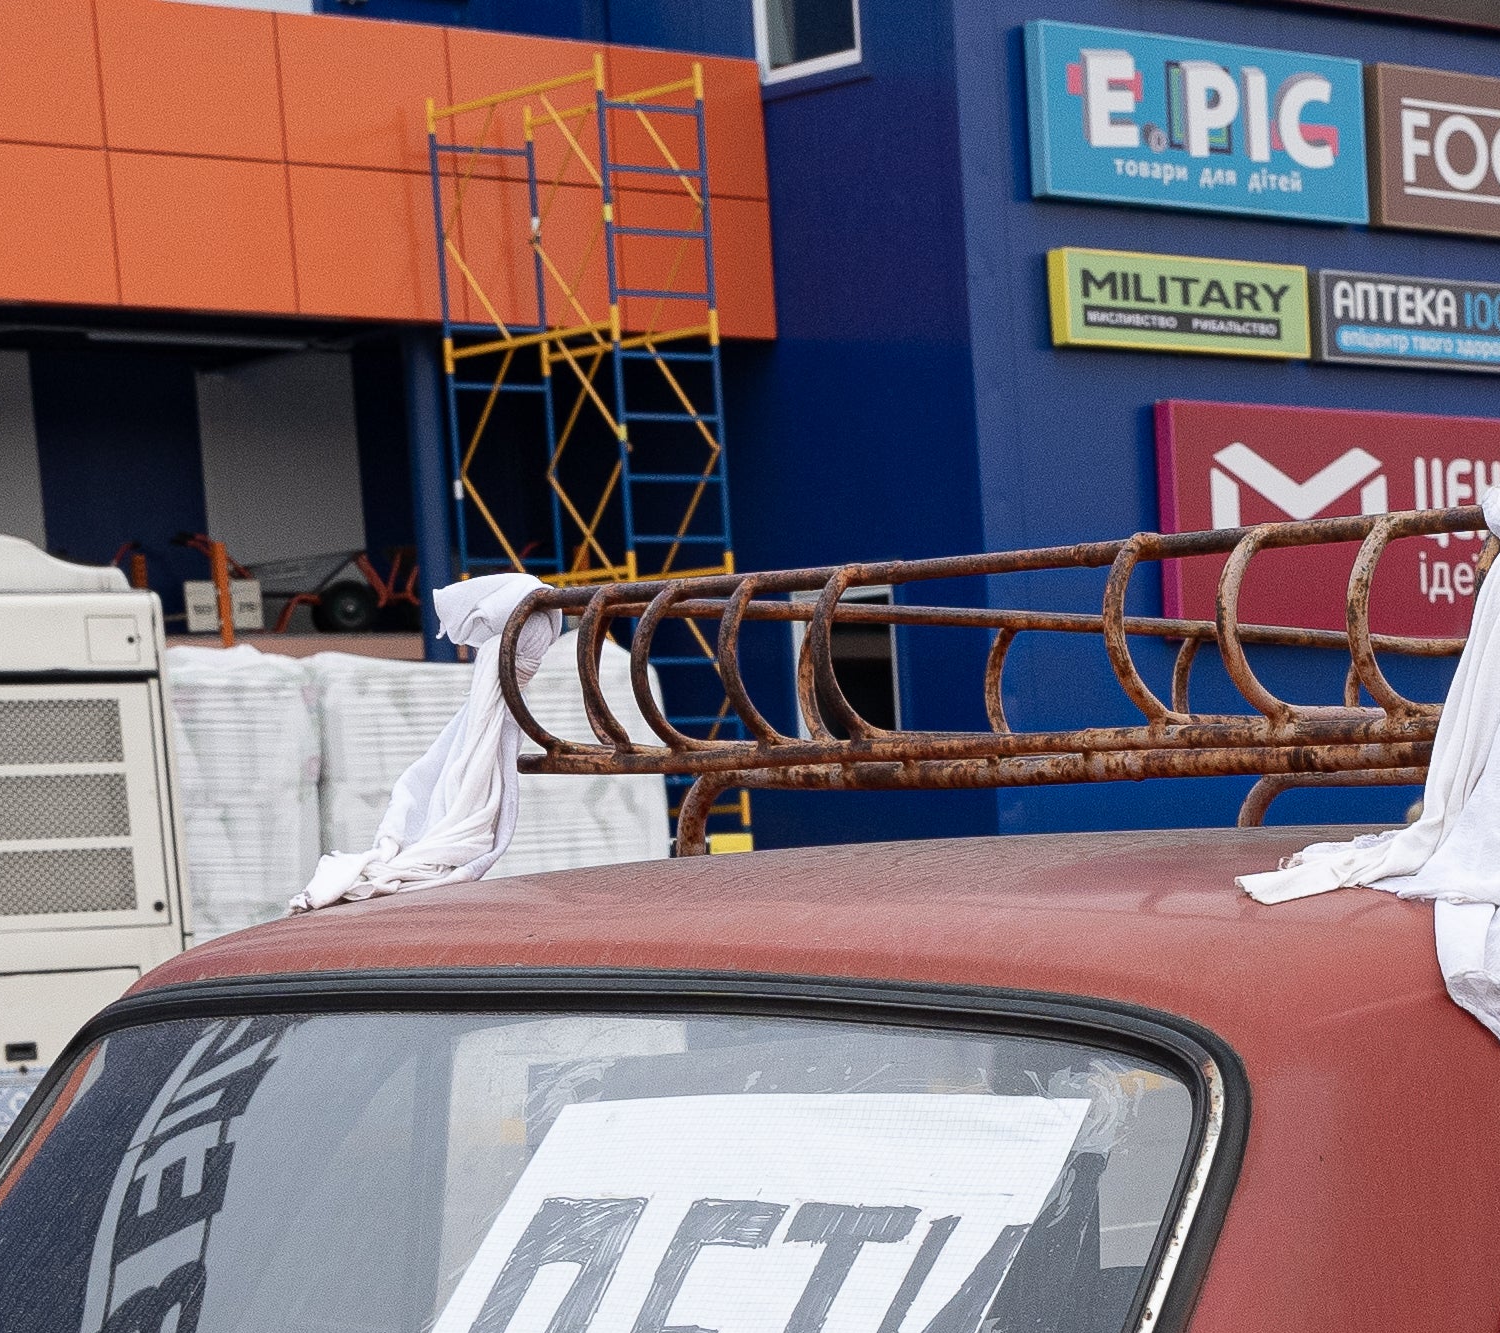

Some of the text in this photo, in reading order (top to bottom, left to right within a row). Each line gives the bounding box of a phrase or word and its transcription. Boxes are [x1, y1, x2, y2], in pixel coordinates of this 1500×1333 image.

[1113, 158, 1303, 194] товари для дітей
[1080, 267, 1290, 313] MILITARY
[1332, 280, 1458, 328] АПТЕКА
[1190, 317, 1279, 337] РИБАЛЬСТВО
